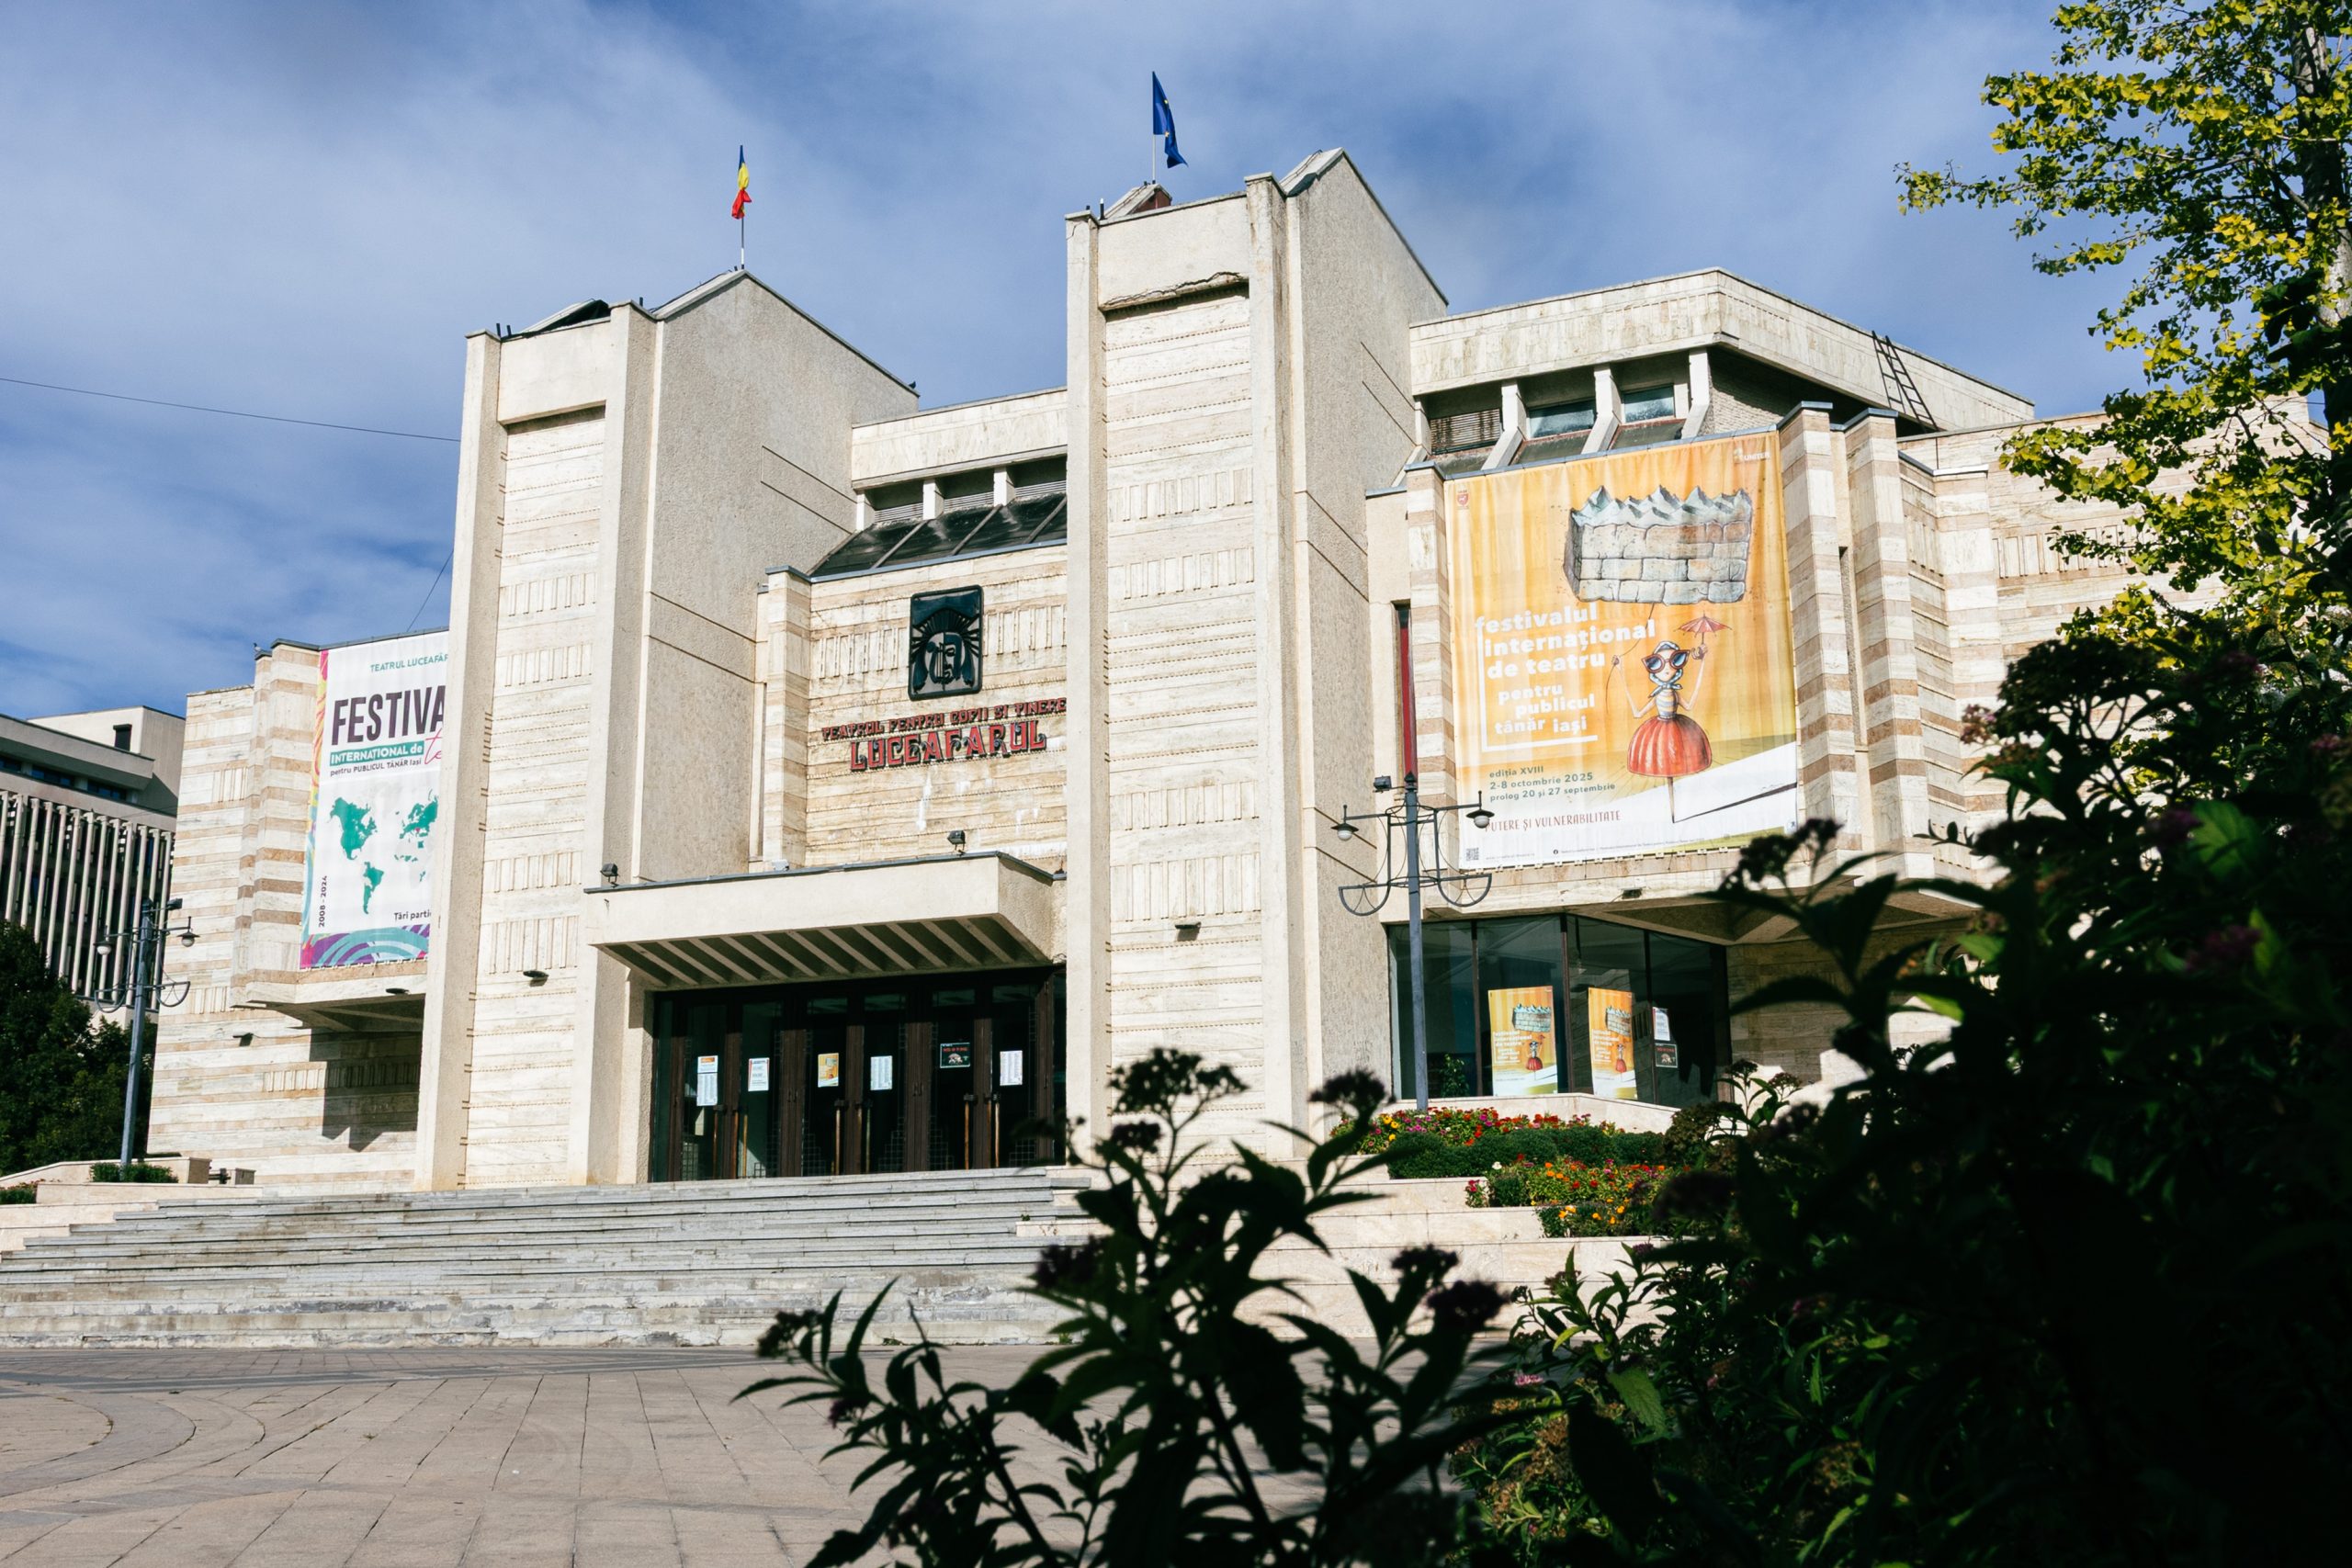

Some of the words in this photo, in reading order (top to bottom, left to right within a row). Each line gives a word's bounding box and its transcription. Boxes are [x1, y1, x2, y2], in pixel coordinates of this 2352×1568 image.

[1475, 602, 1598, 634] festivalul
[1484, 618, 1657, 658] internațional
[370, 660, 405, 673] TEATRUL
[1487, 660, 1519, 680] de
[1525, 652, 1606, 675] teatru
[1498, 683, 1563, 706] pentru
[1515, 693, 1596, 719] publicul
[821, 720, 884, 741] TEATRUL
[888, 712, 944, 733] PENTRU
[950, 706, 989, 725] COPII
[410, 742, 423, 754] de
[850, 719, 1047, 772] LUCEAFARUL
[330, 767, 352, 777] pentru
[353, 763, 385, 773] PUBLICUL
[1489, 781, 1508, 790] 2-8
[1510, 776, 1561, 788] octombrie
[1565, 772, 1593, 783] 2025
[1520, 765, 1544, 774] XVIII
[1489, 793, 1520, 803] prolog
[1522, 789, 1535, 798] 20
[1548, 787, 1561, 796] 27
[1564, 783, 1616, 795] septembrie
[1534, 809, 1622, 827] VULNERABILITATE
[318, 905, 326, 928] 2008
